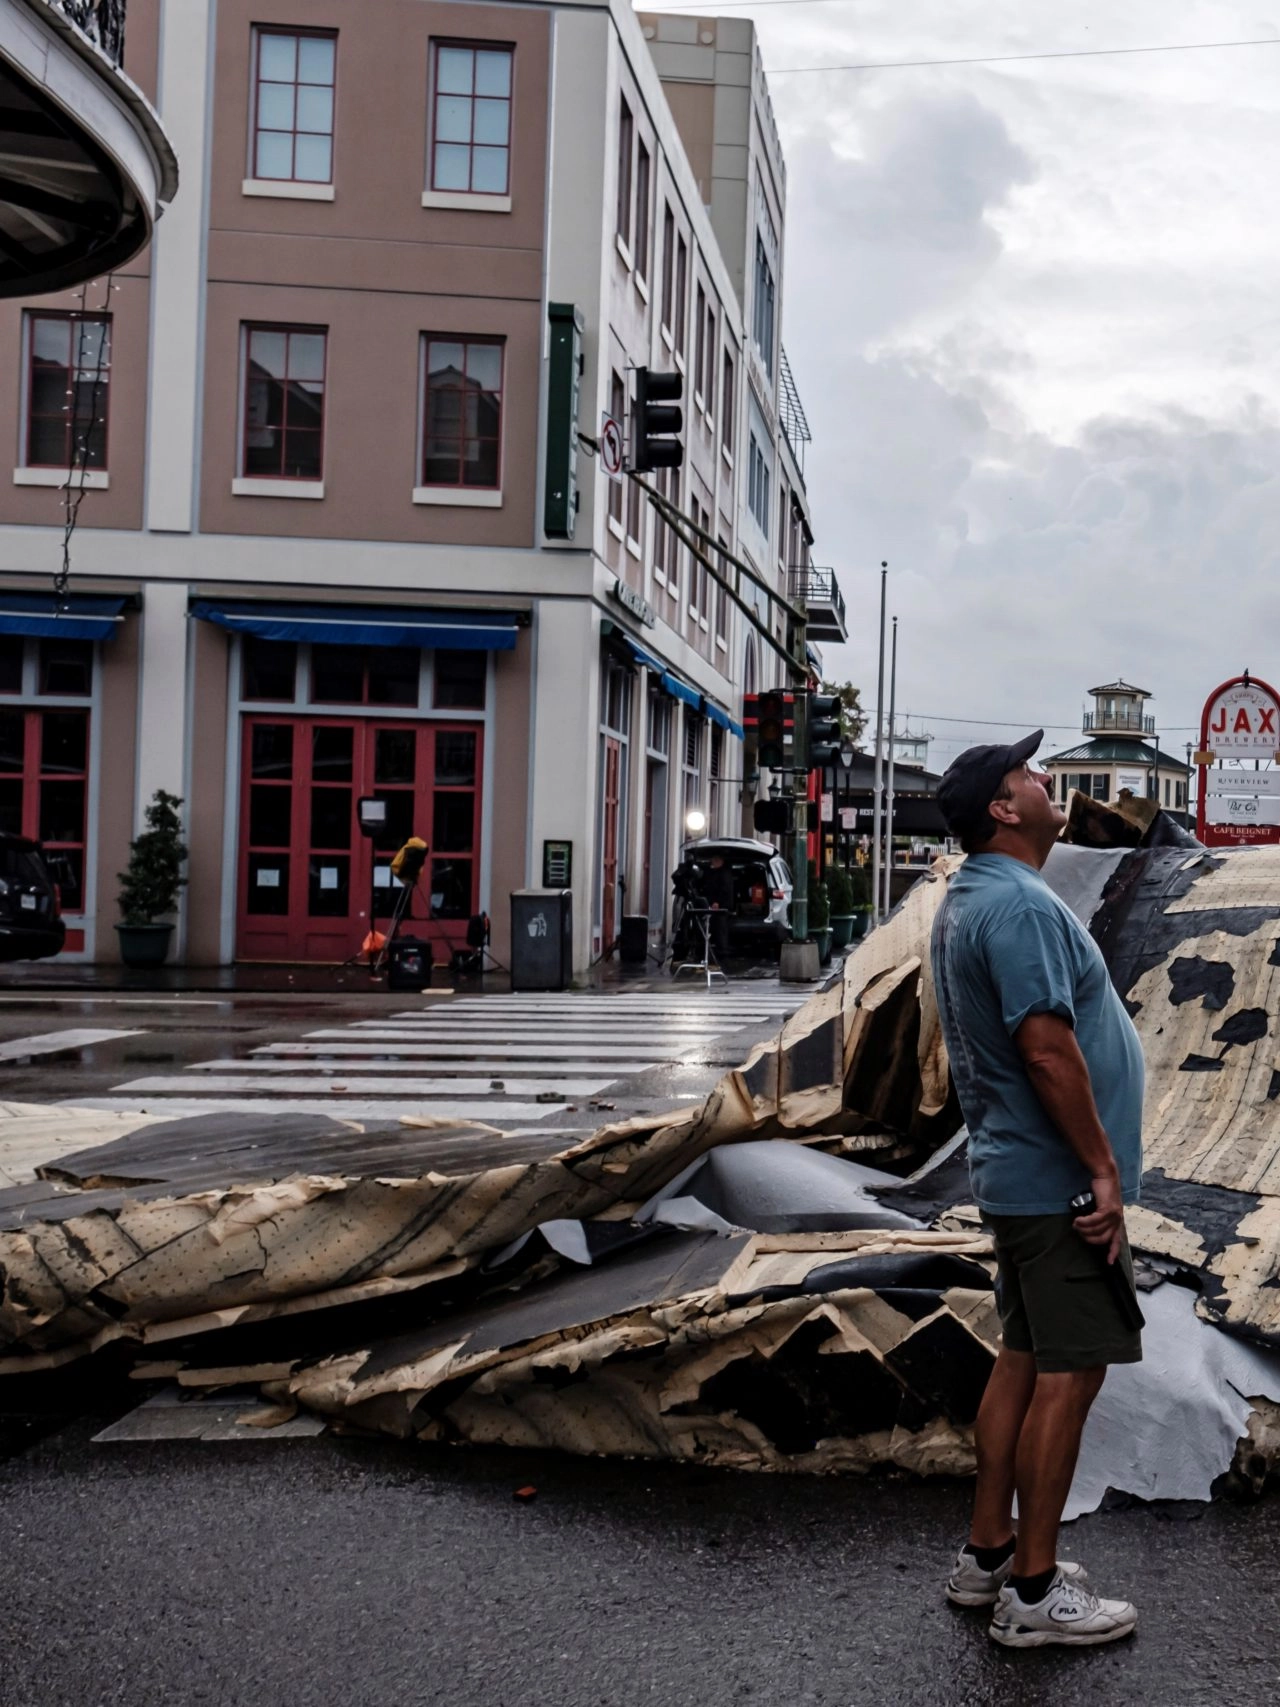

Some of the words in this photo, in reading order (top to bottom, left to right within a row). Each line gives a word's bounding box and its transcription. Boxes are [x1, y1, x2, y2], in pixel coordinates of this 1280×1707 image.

[1215, 736, 1276, 744] BREWERY
[1217, 777, 1270, 785] RIVERVIEW
[1213, 826, 1235, 835] CAFE
[1236, 827, 1272, 836] BEIGNET
[1058, 1607, 1078, 1615] FILA
